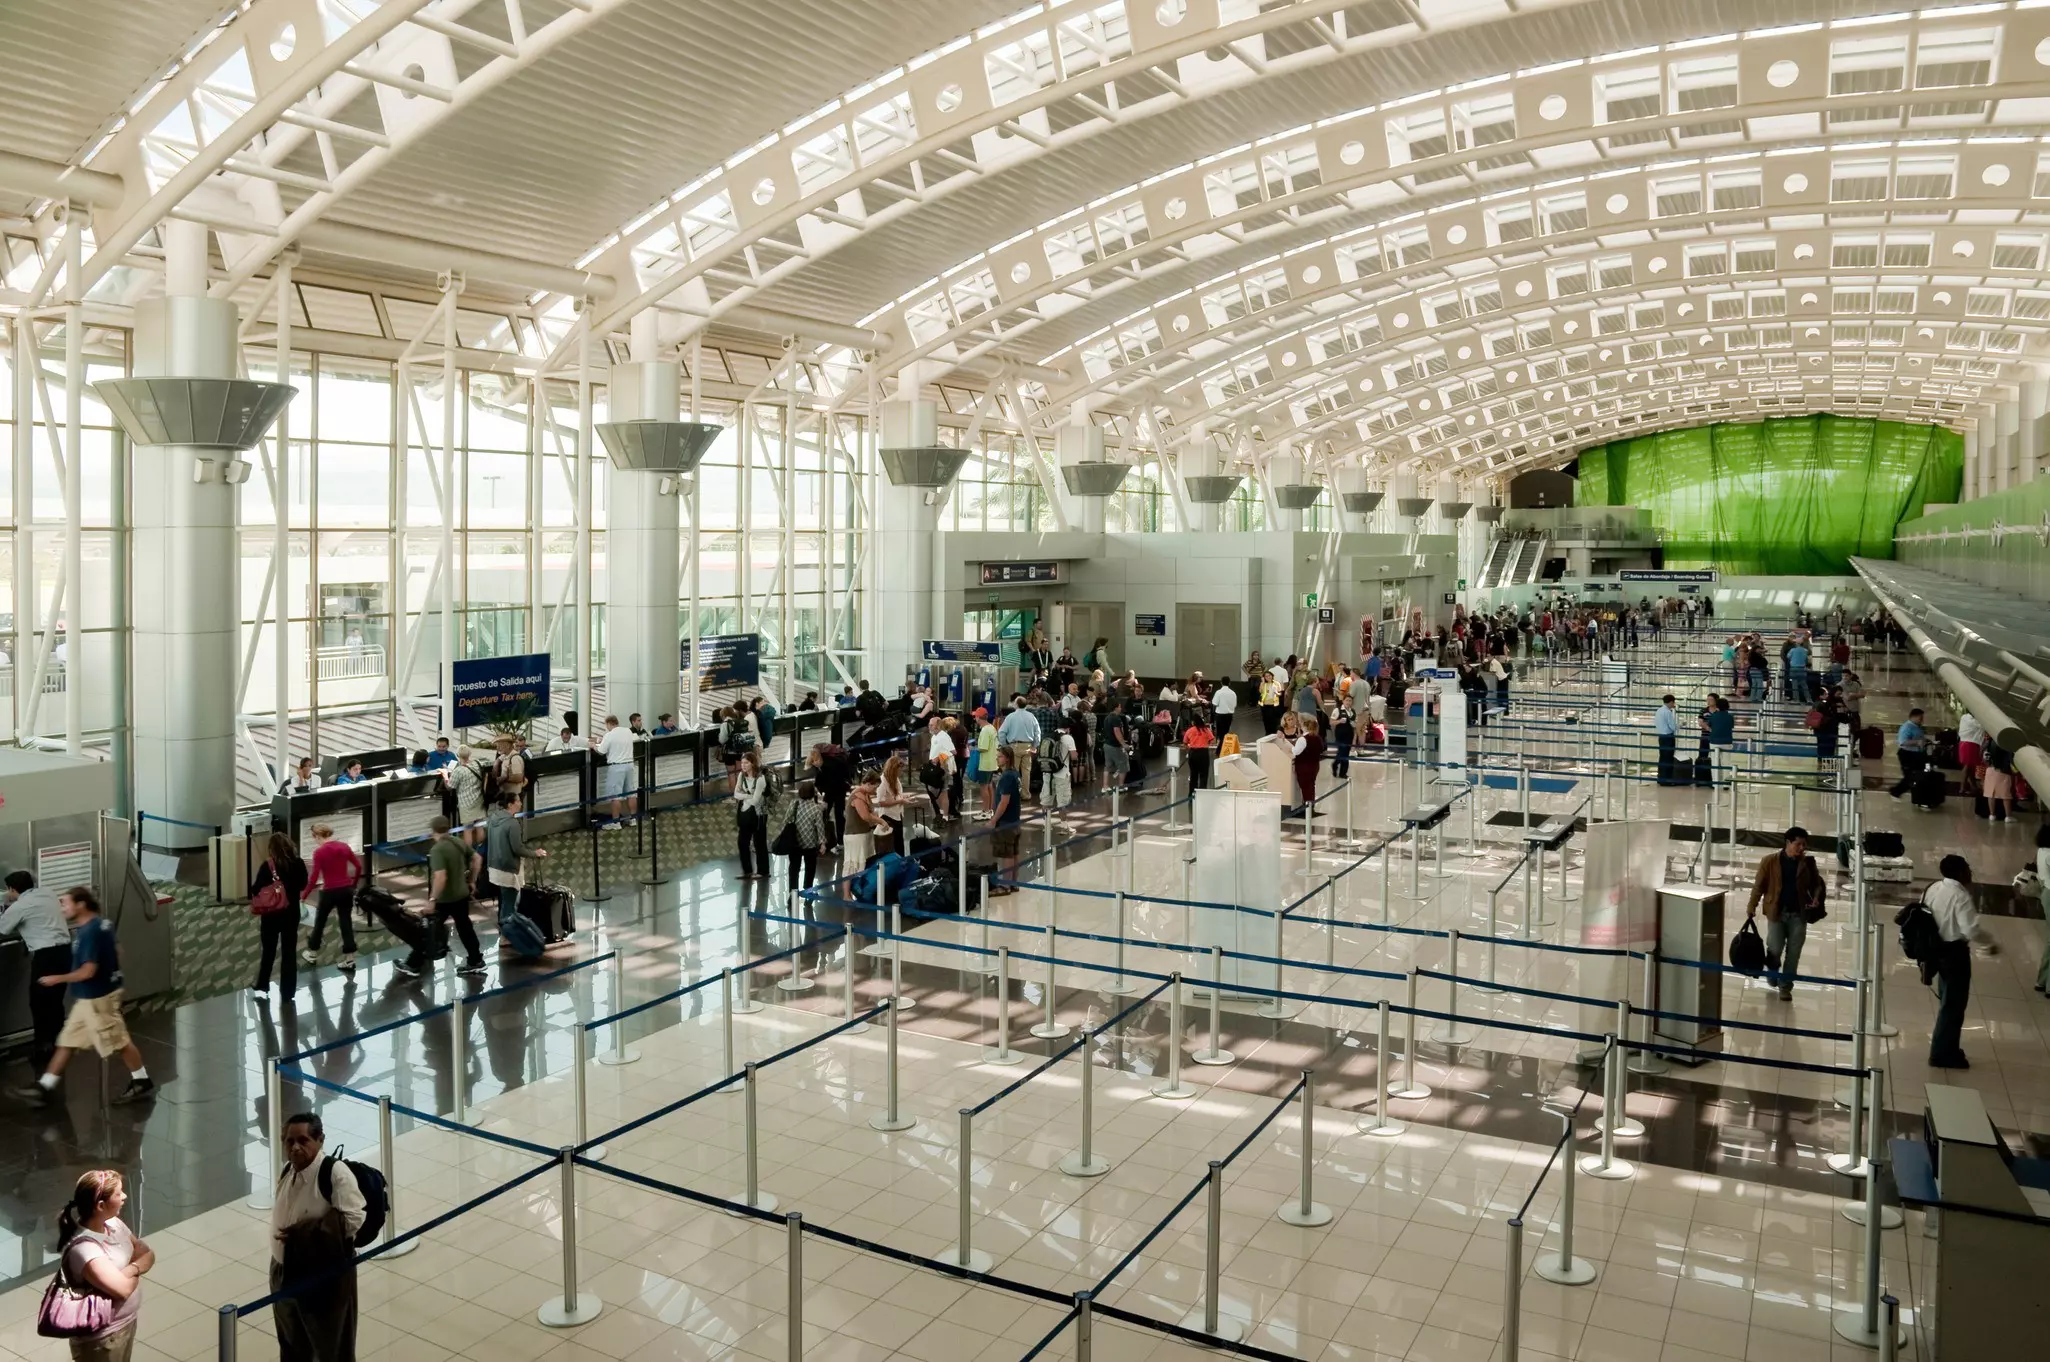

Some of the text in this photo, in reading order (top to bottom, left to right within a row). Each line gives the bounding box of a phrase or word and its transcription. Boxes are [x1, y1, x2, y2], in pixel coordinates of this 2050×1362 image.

[1650, 573, 1670, 581] Abordaje
[453, 680, 487, 693] mpuesto
[488, 679, 498, 688] de
[500, 676, 524, 687] Salida
[458, 695, 499, 708] Departure
[501, 692, 514, 702] Tax
